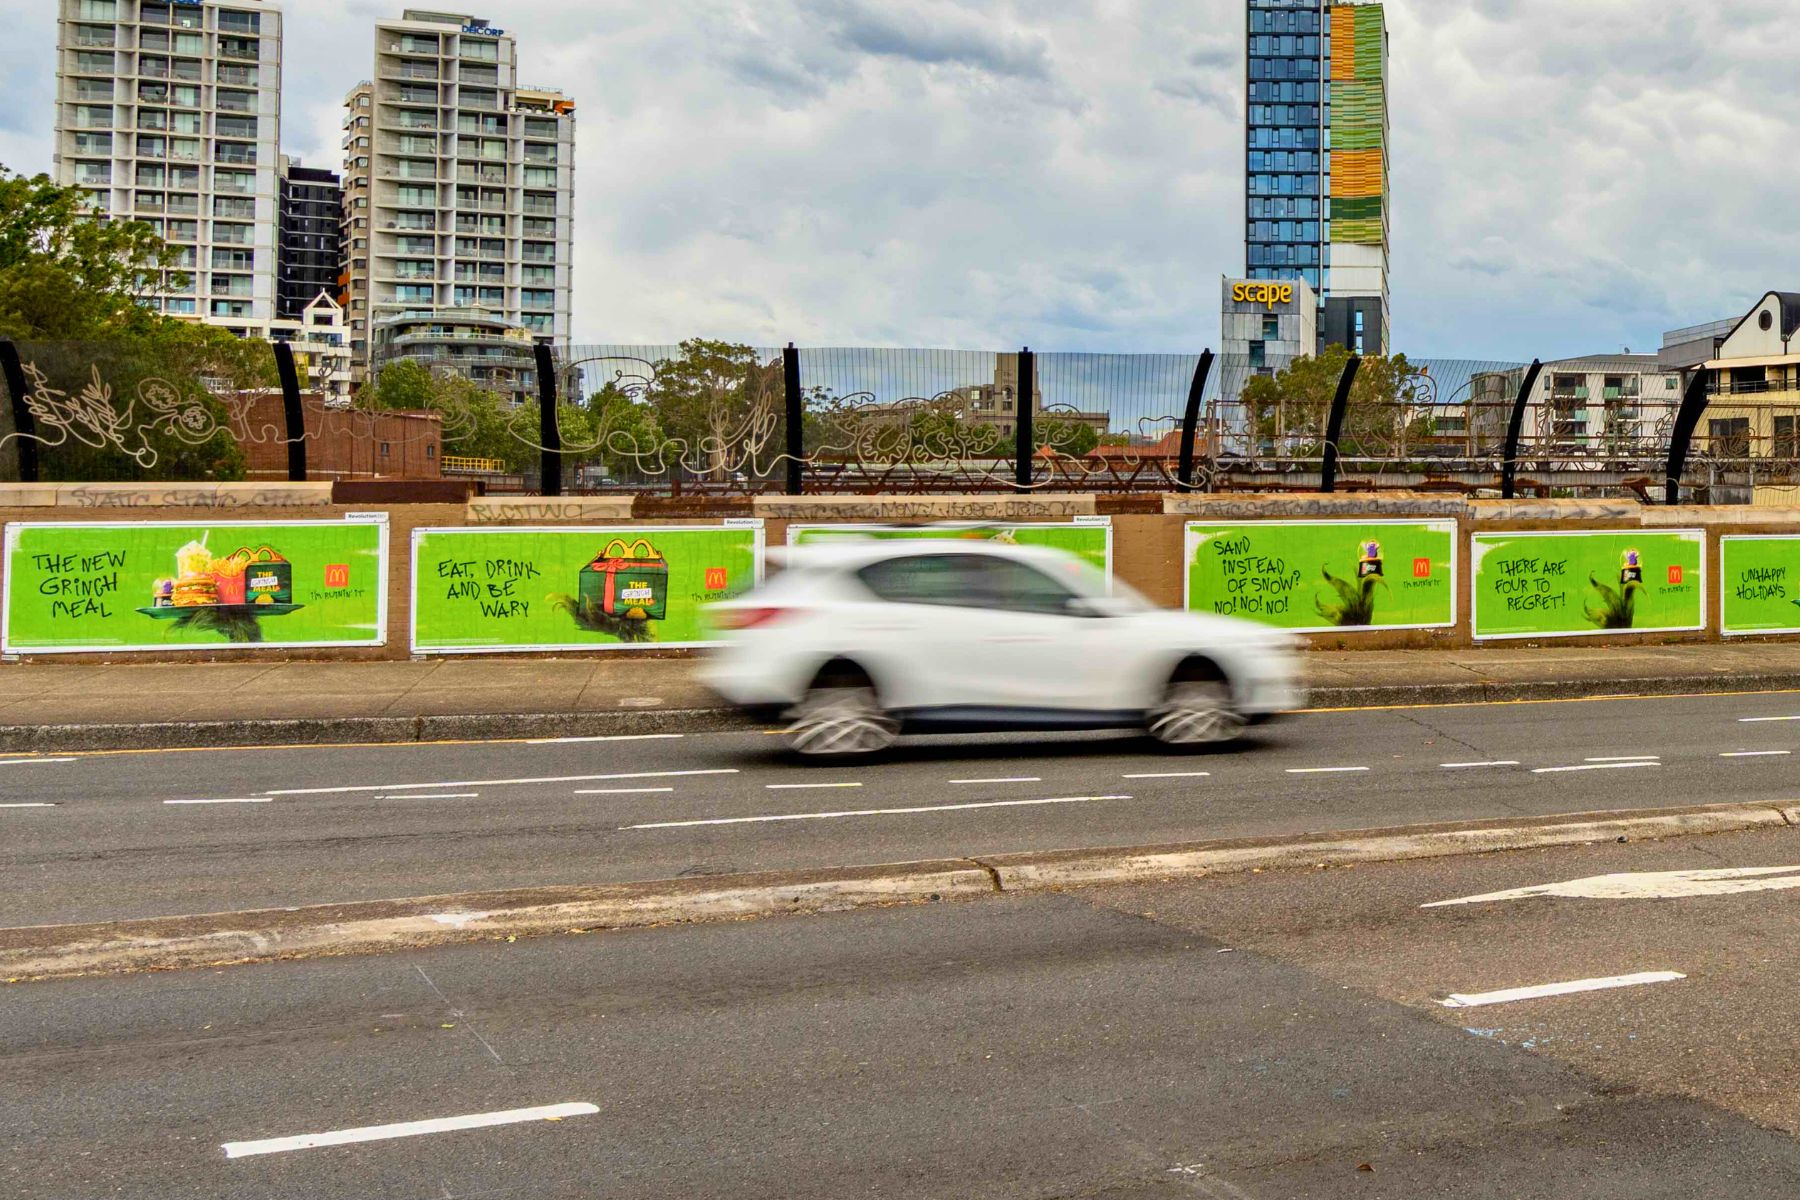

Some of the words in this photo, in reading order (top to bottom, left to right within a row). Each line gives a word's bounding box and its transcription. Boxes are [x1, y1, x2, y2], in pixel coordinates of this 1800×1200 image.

[1233, 283, 1292, 310] scape
[1213, 536, 1251, 555] SAND
[32, 554, 77, 573] THE
[81, 550, 126, 573] NEW
[1496, 558, 1540, 576] THERE
[1543, 560, 1567, 576] ARE
[1227, 578, 1248, 594] OF
[1251, 570, 1301, 594] SNOW?
[1741, 567, 1786, 582] UNHAPPY
[447, 581, 480, 600] AND
[487, 578, 518, 597] BE
[1495, 577, 1528, 594] FOUR
[1533, 578, 1550, 593] TO
[53, 598, 112, 618] MEAL
[480, 600, 529, 618] WARY
[1214, 596, 1237, 616] NO!
[1240, 595, 1263, 613] NO!
[1266, 596, 1289, 615] NO!
[1507, 592, 1566, 611] REGRET!
